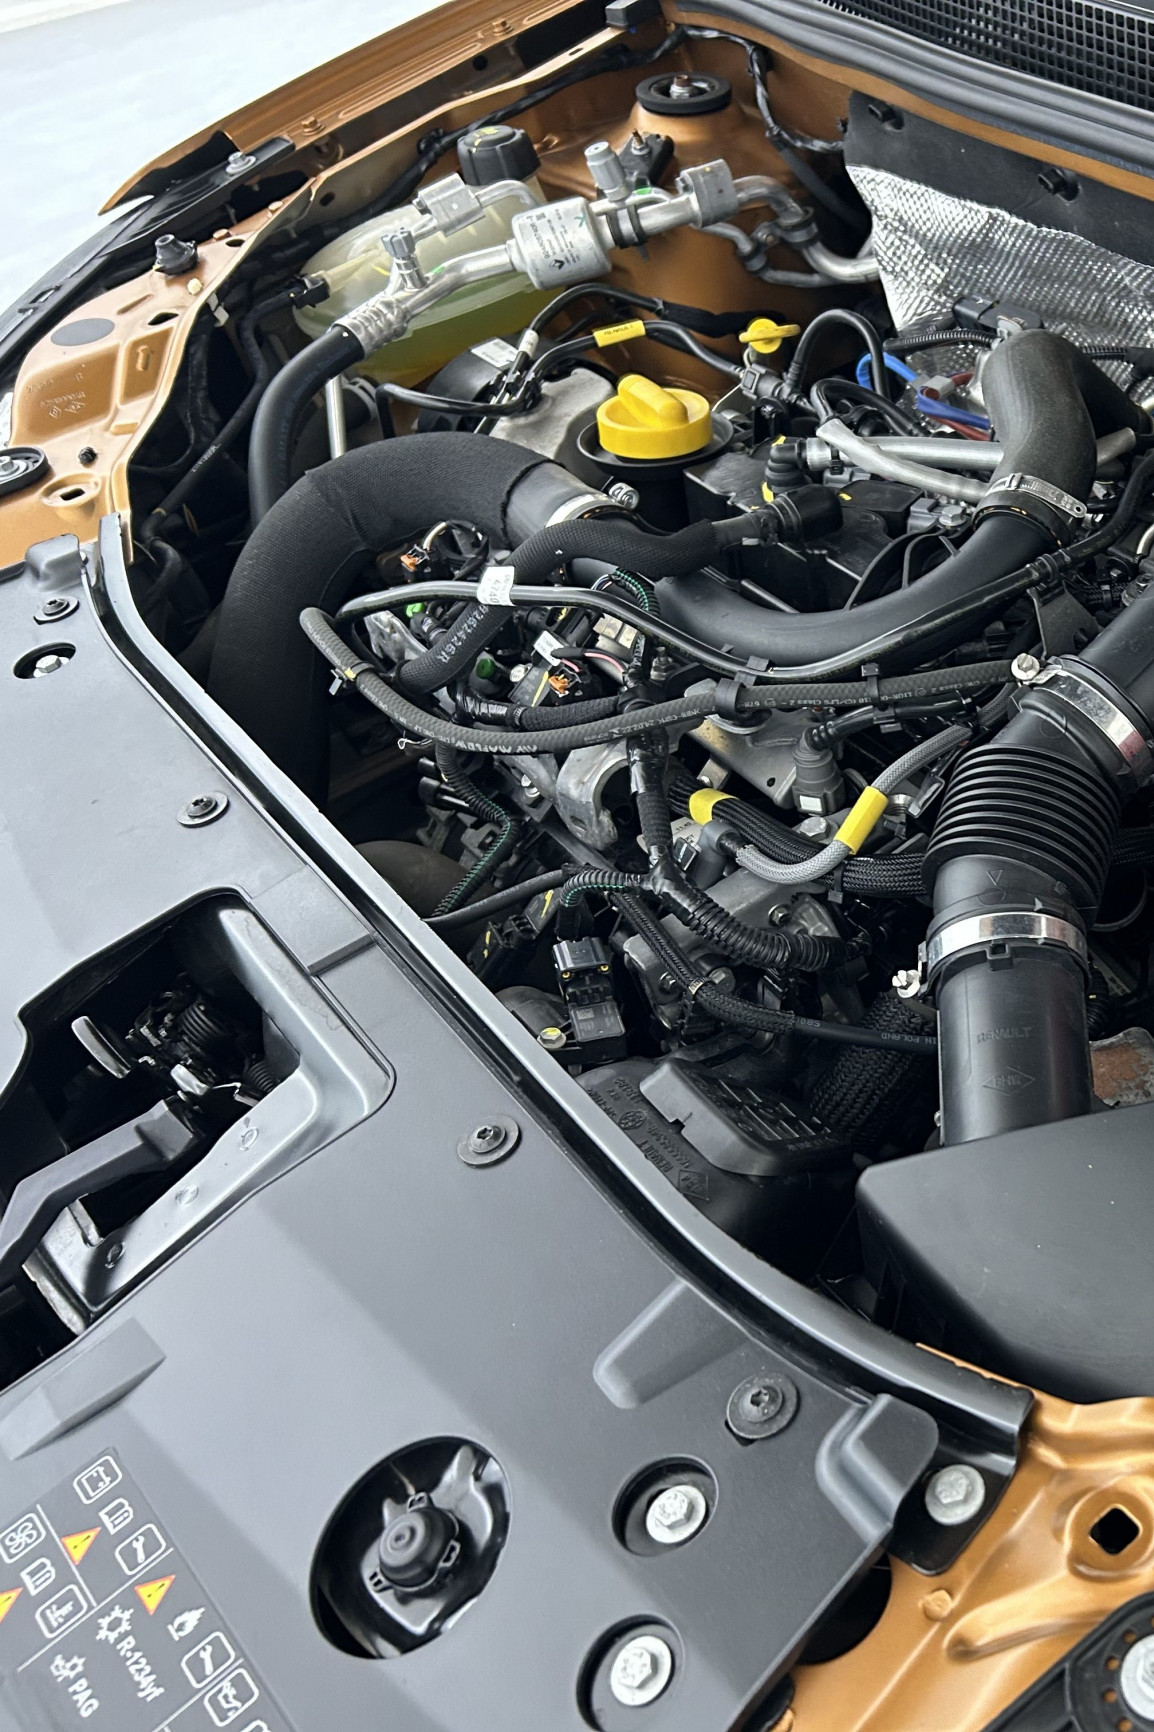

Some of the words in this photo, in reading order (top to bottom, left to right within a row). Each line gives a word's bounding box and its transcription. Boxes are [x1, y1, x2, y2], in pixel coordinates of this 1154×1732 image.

[880, 1032, 919, 1043] POLAND
[976, 1025, 1032, 1042] RENAULT
[68, 1677, 99, 1717] PAG
